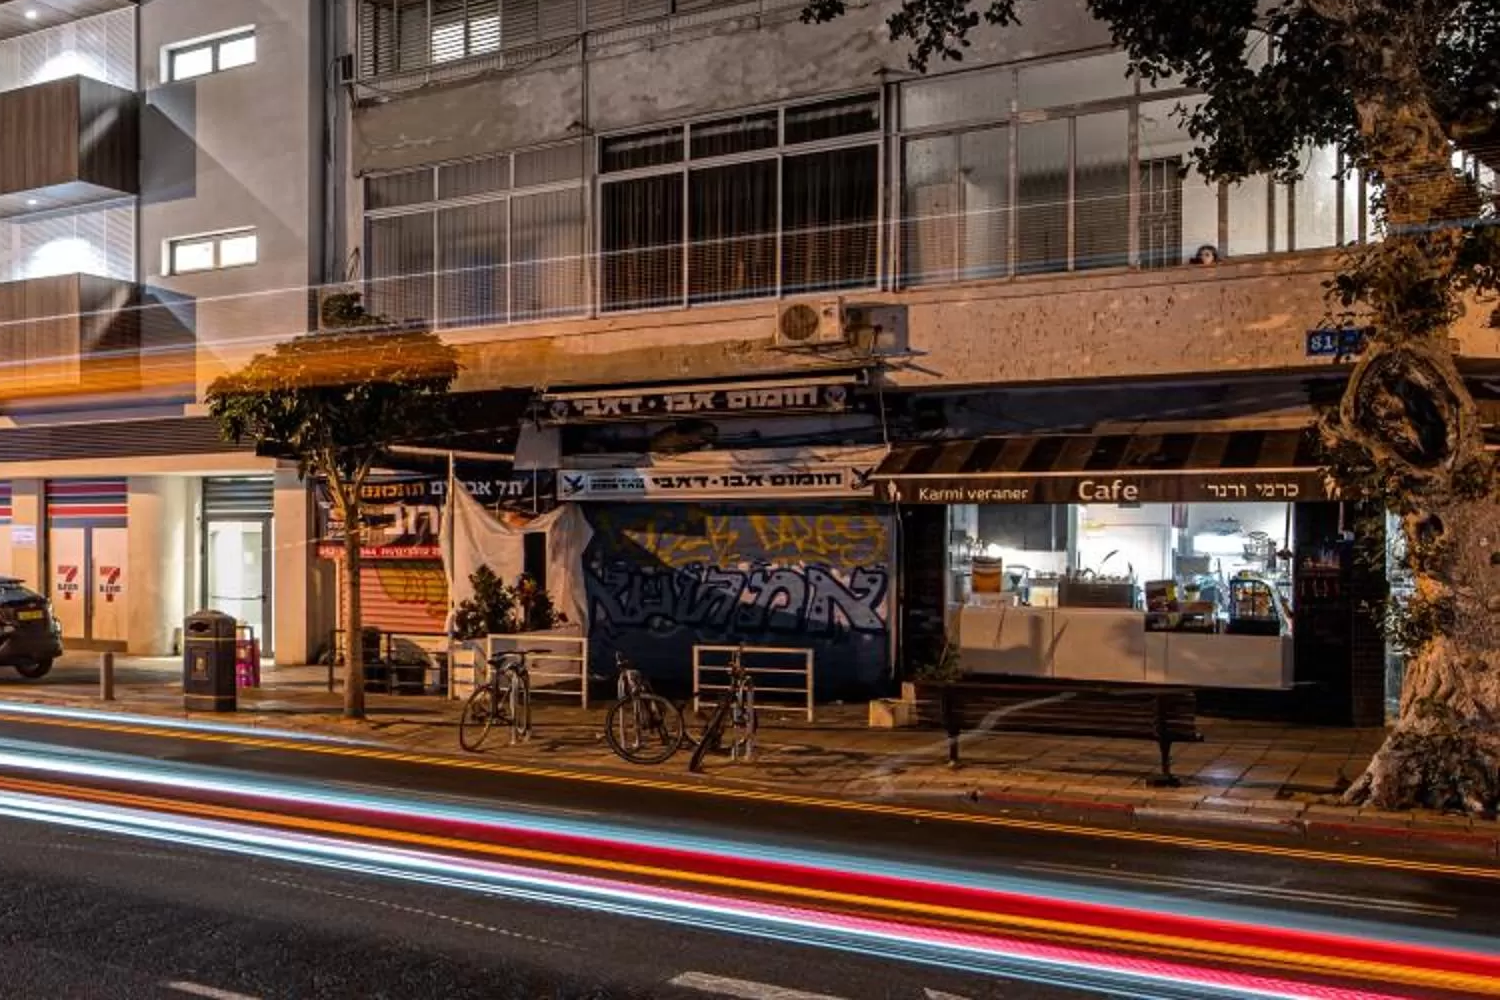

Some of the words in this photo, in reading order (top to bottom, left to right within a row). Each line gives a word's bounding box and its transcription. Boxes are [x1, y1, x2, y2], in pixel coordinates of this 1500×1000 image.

[663, 391, 717, 412] אבו
[727, 386, 818, 409] חומוס
[573, 397, 643, 417] דאבי
[651, 475, 710, 489] דאבי
[717, 473, 764, 488] אבו
[769, 471, 843, 488] חומוס
[918, 487, 963, 501] Karmi
[967, 488, 1029, 501] veraner
[1078, 479, 1140, 501] Cafe
[1255, 483, 1300, 497] כרמי
